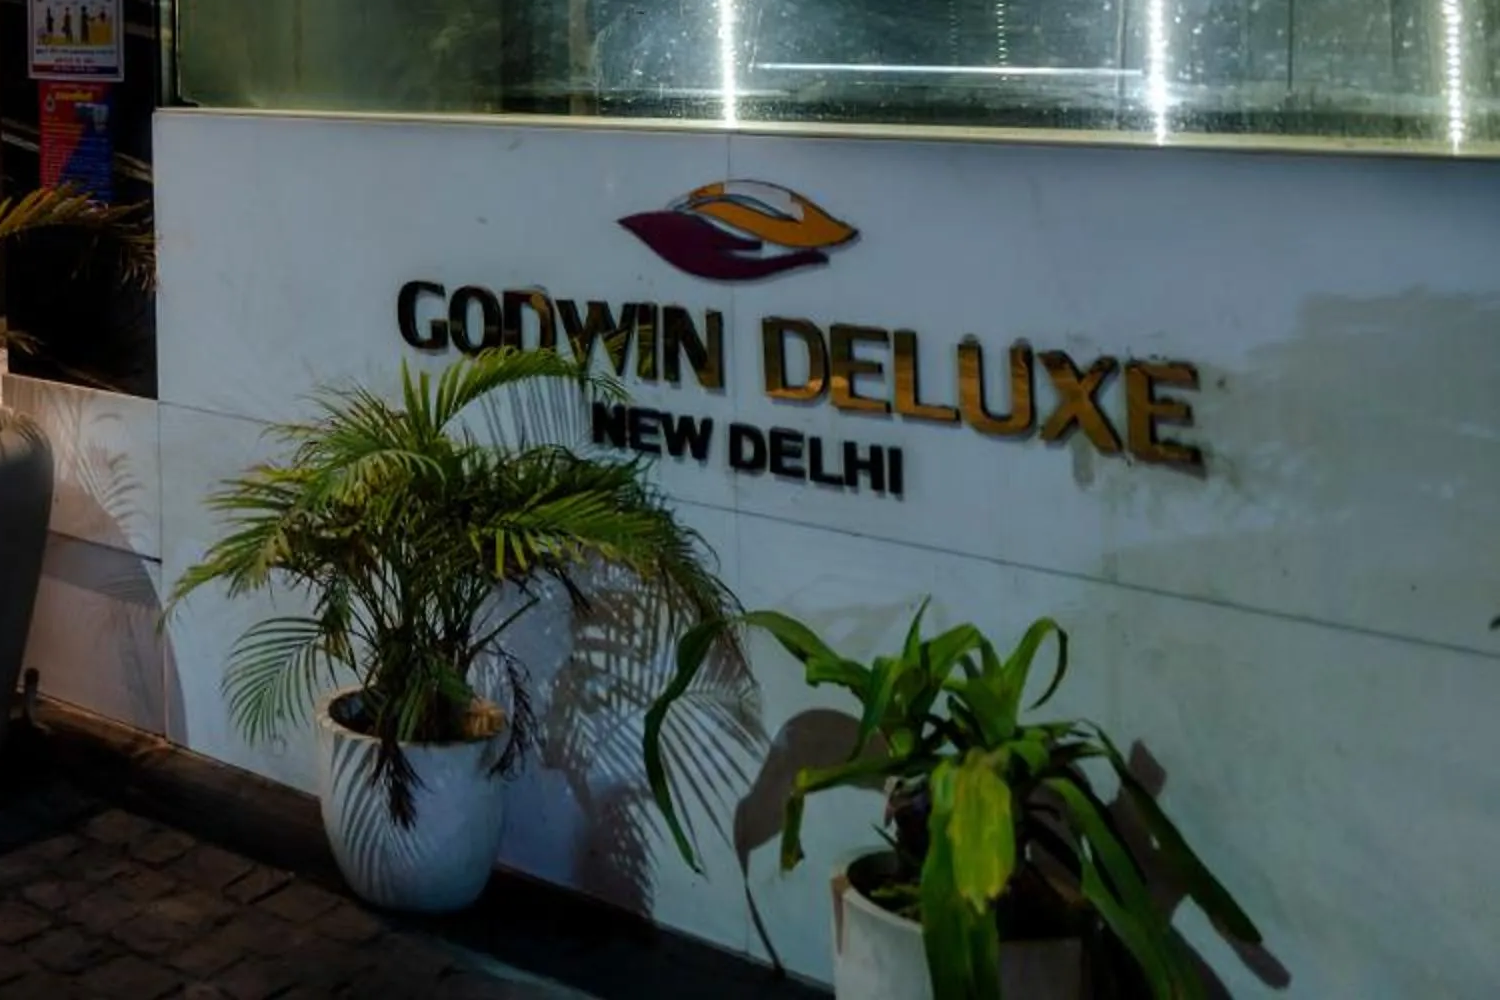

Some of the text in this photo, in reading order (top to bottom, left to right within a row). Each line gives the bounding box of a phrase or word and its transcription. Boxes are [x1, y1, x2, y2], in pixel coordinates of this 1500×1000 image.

[397, 279, 1204, 471] GODWIN DELUXE
[591, 402, 904, 498] NEW DELHI
